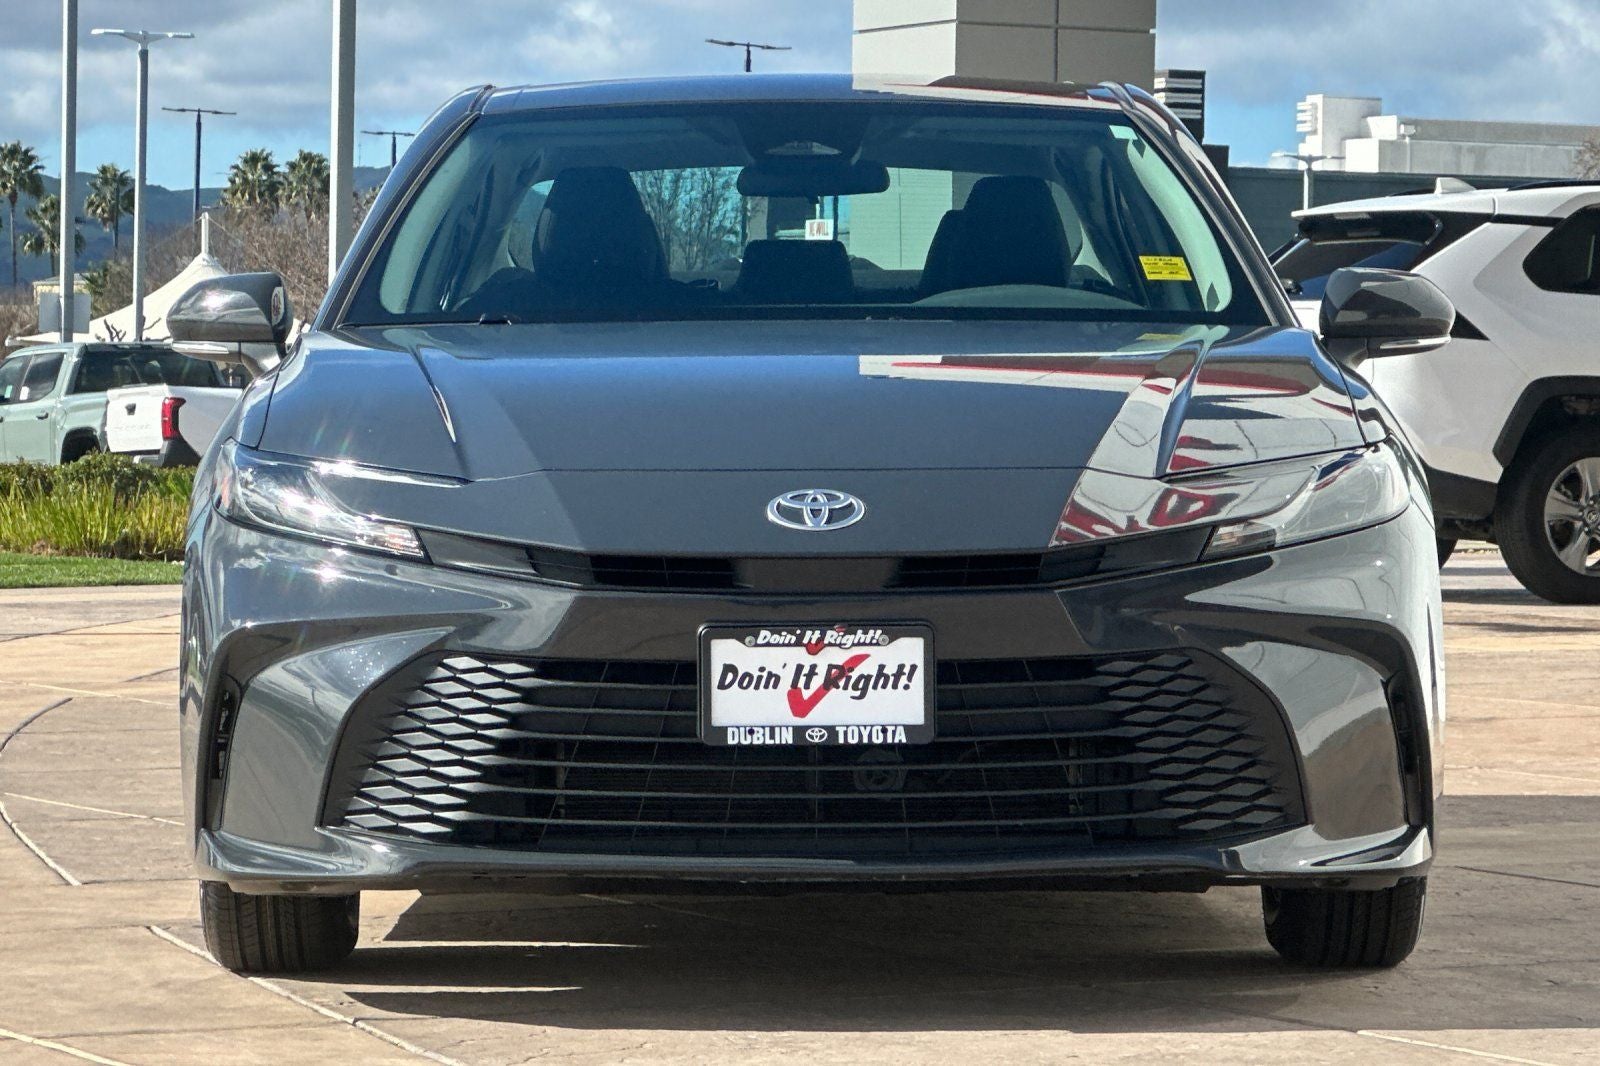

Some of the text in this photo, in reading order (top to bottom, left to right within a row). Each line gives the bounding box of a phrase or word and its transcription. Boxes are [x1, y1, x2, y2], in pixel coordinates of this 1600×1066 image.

[757, 629, 882, 649] Doin' It Right!
[717, 663, 918, 700] Doin' It Right!
[727, 726, 907, 745] DUBLIN TOYOTA
